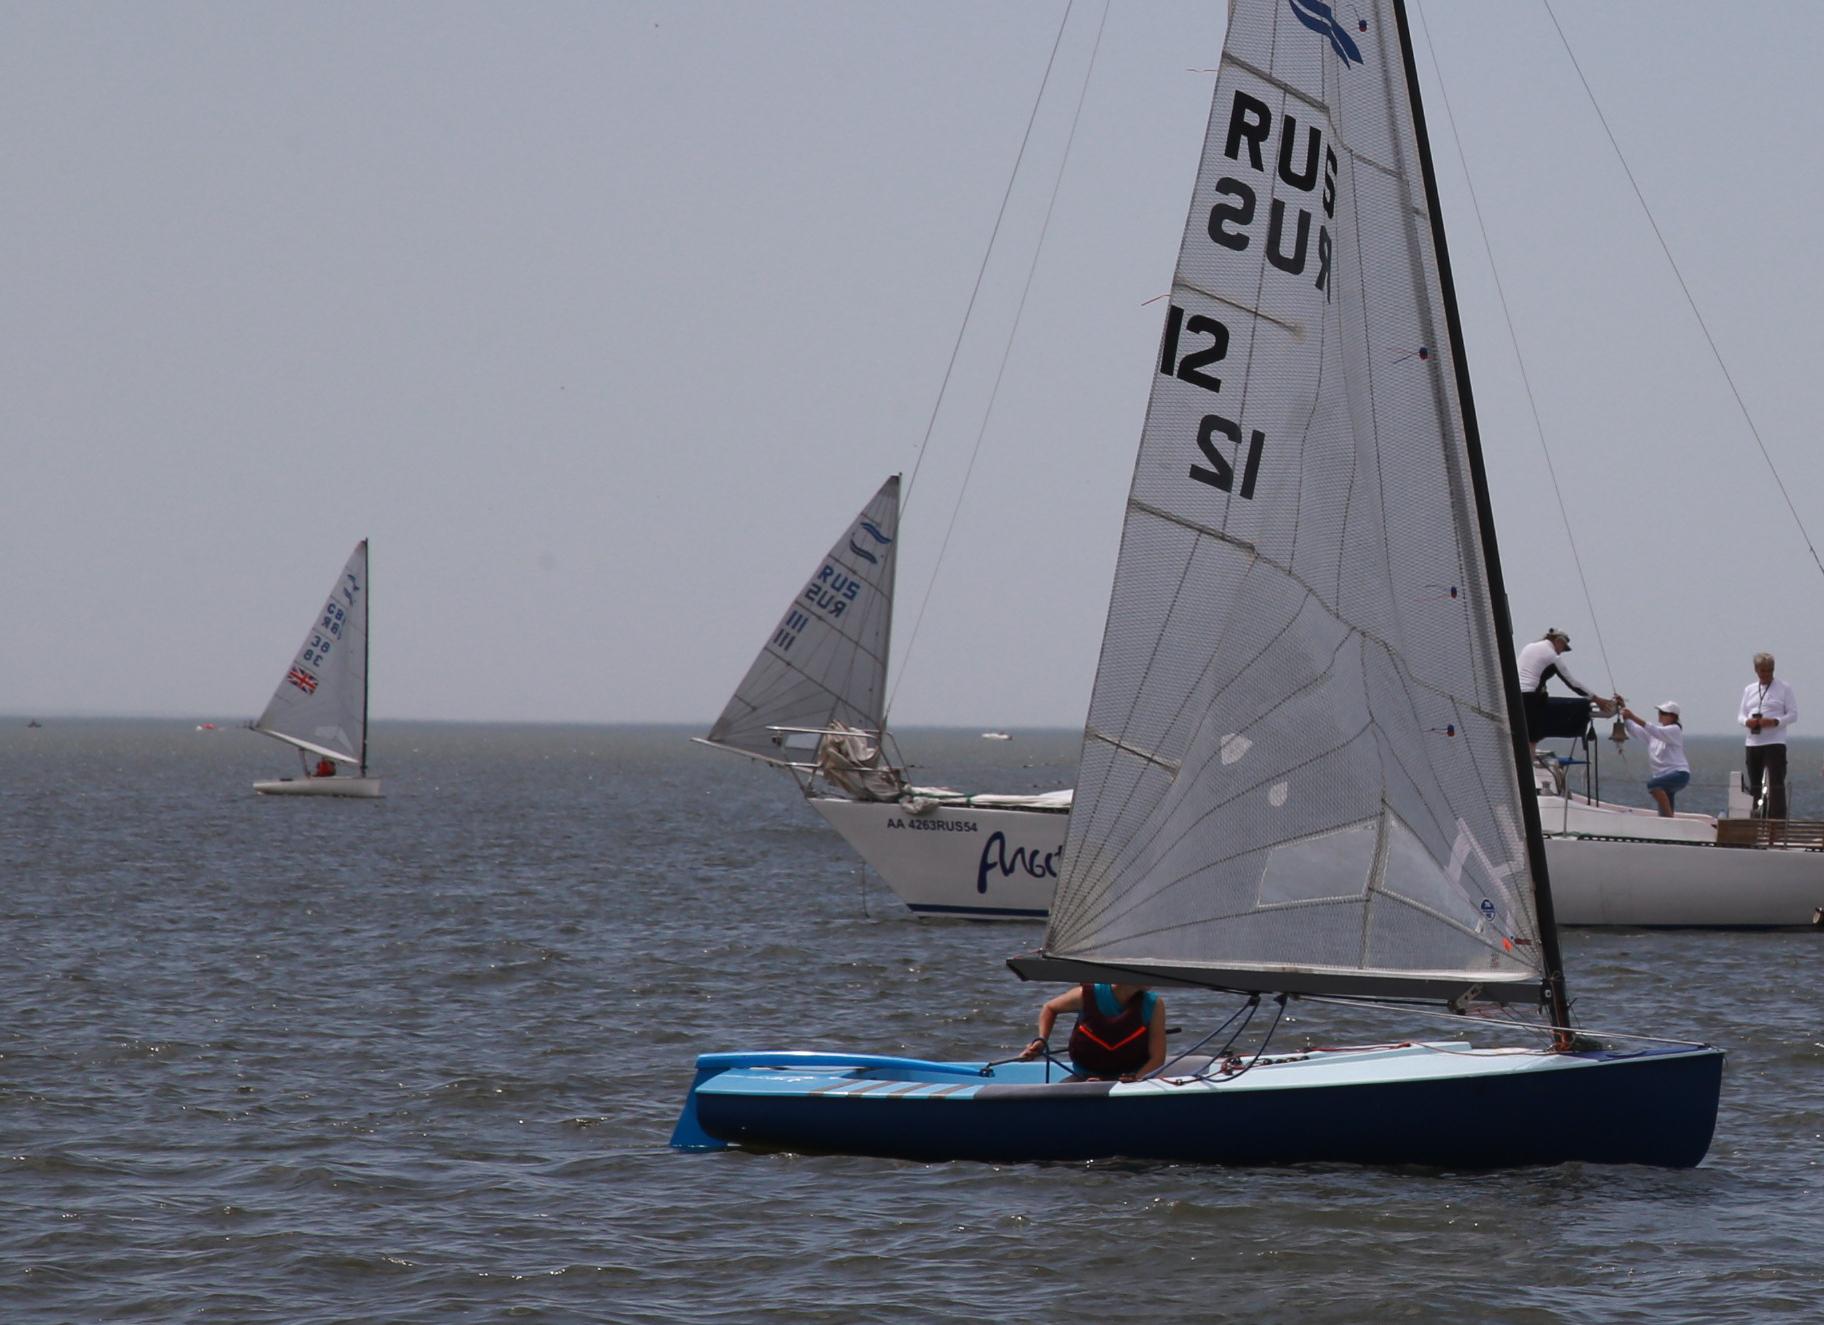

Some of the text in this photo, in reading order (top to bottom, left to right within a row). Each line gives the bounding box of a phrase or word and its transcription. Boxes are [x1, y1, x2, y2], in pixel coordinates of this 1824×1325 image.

[1224, 89, 1338, 220] RUS
[1159, 305, 1231, 394] 12
[817, 564, 861, 601] RUS
[327, 603, 345, 624] GB
[310, 634, 331, 653] 38
[887, 818, 978, 832] AA 4263RUS54
